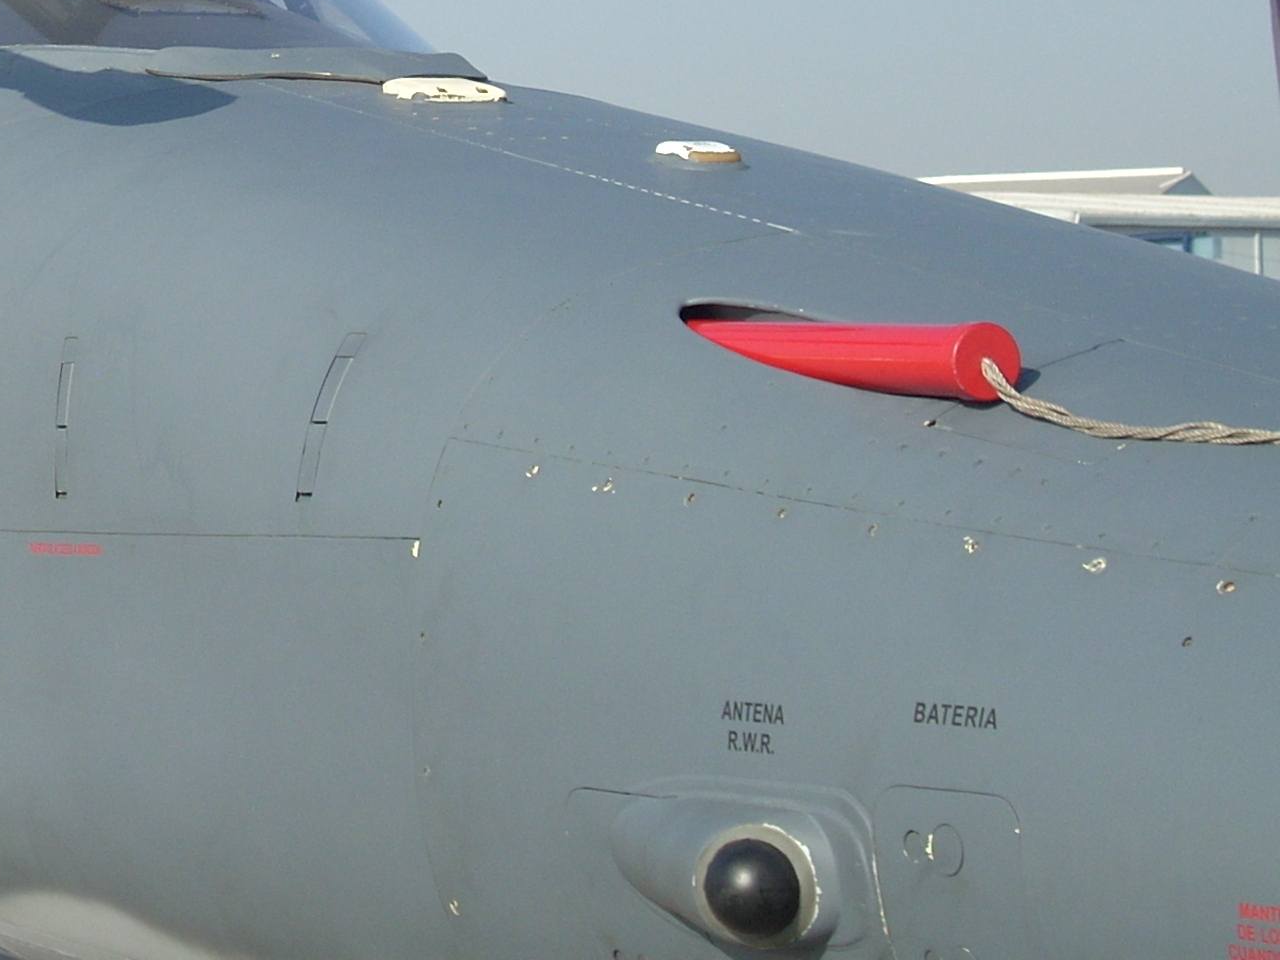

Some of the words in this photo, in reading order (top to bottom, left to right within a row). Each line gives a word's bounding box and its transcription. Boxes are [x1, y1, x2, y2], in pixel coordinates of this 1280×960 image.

[721, 700, 785, 726] ANTENA
[913, 701, 998, 730] BATERIA
[727, 730, 775, 755] R.W.R.
[1239, 902, 1280, 921] MANT
[1236, 923, 1256, 942] DE
[1260, 928, 1280, 945] LO
